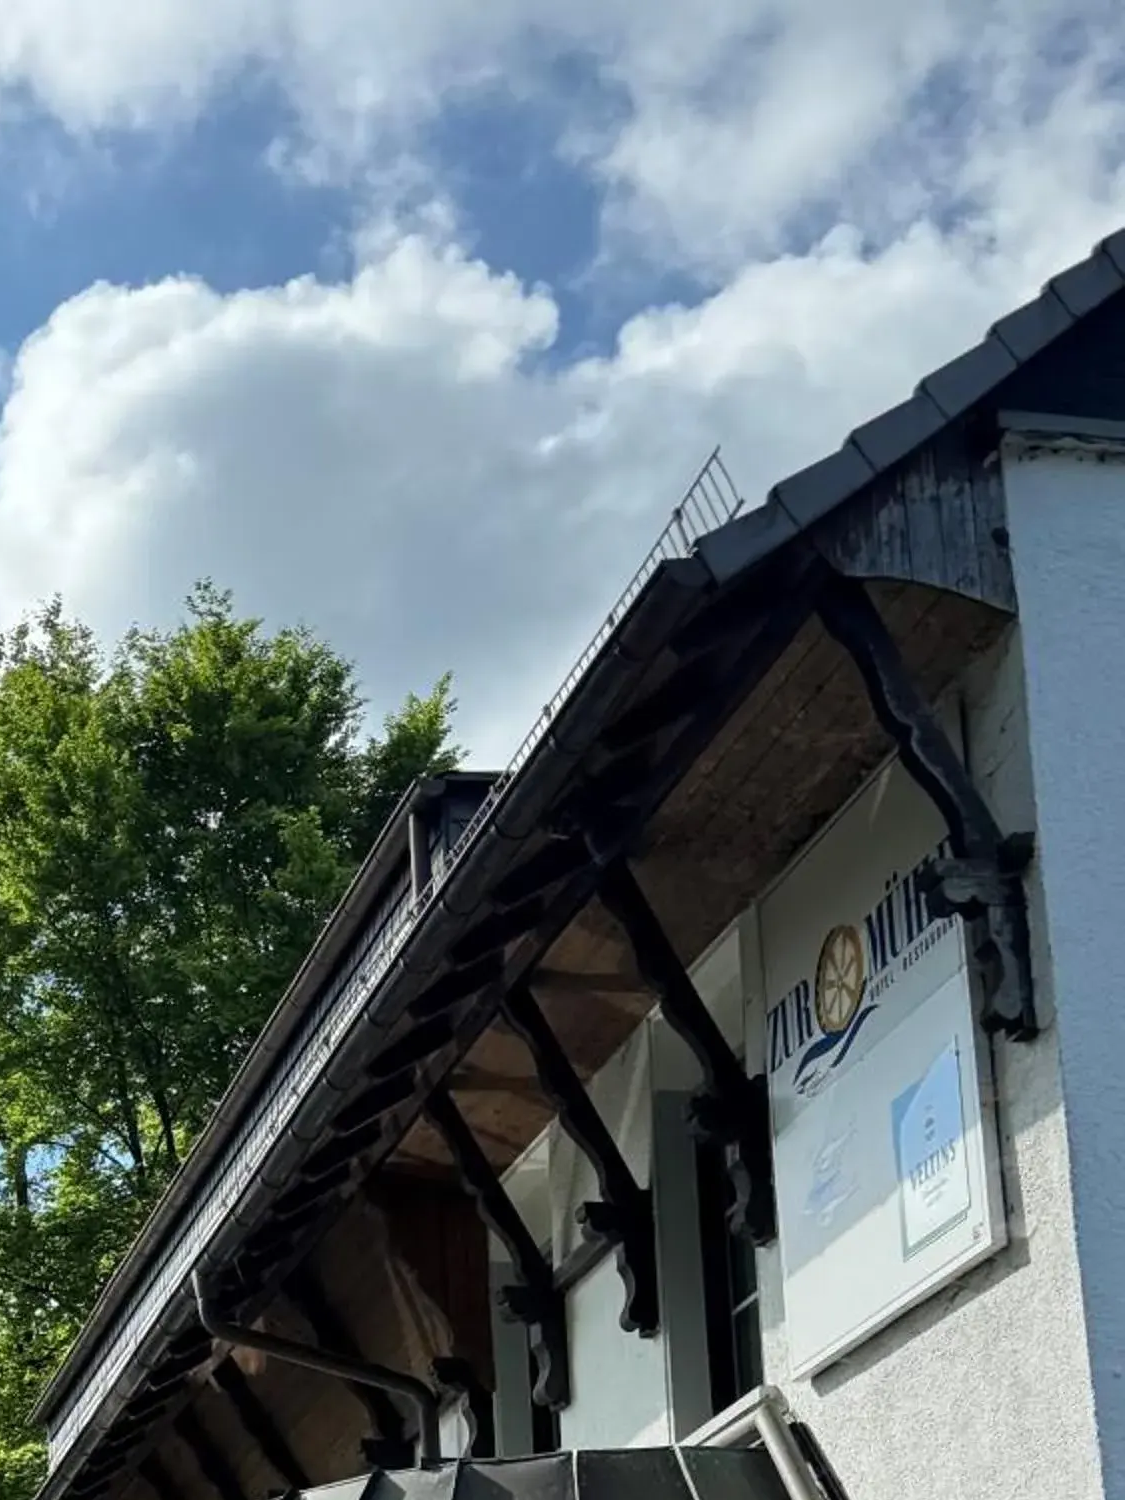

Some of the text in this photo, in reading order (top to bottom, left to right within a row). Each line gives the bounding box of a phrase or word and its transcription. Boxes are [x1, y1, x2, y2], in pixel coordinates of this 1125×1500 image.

[766, 979, 814, 1075] ZUR
[864, 836, 952, 976] MÜH
[909, 1137, 957, 1191] VELTINS
